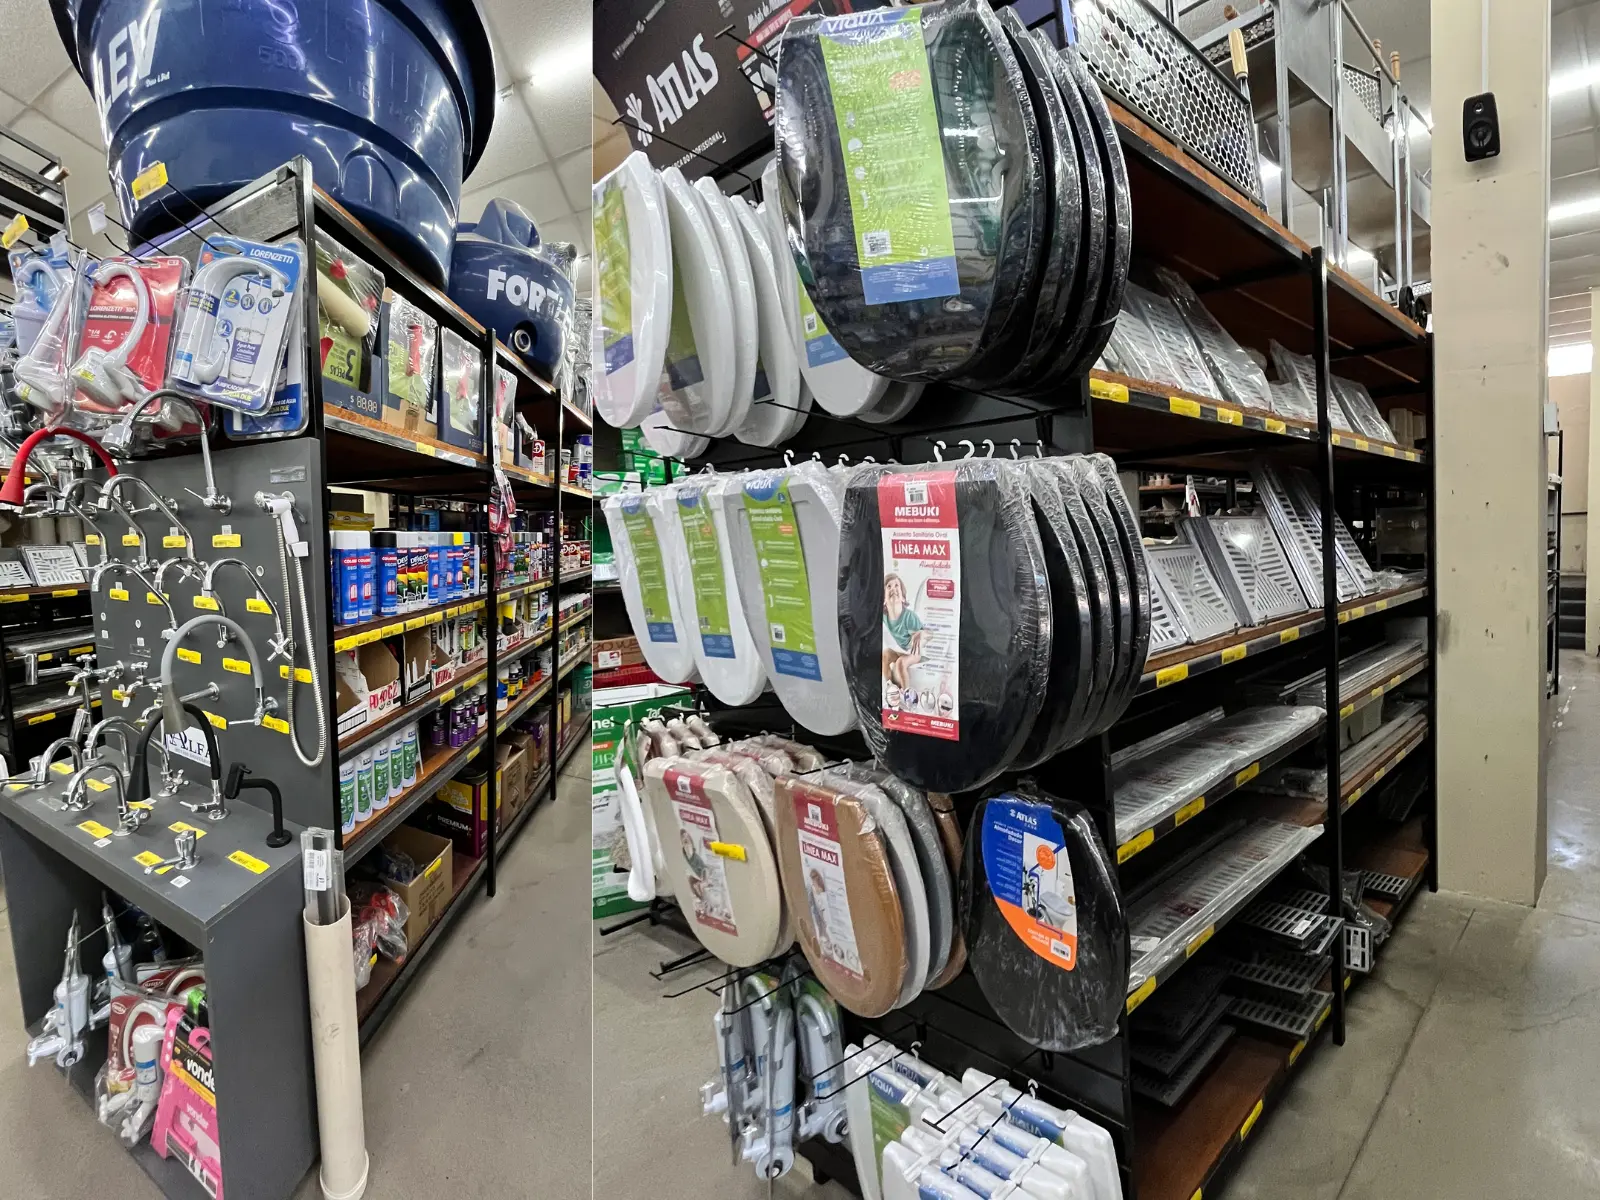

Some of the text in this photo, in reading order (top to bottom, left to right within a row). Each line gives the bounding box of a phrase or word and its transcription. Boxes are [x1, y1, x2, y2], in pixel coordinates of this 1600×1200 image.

[646, 32, 719, 133] ATLAS
[250, 247, 295, 264] LORENZETTI
[329, 364, 346, 380] PEÇAS
[894, 506, 940, 517] MEBUKI
[922, 544, 946, 556] MAX
[930, 718, 955, 729] MEBUKI
[1016, 811, 1037, 826] ATLAS
[820, 850, 837, 864] MAX
